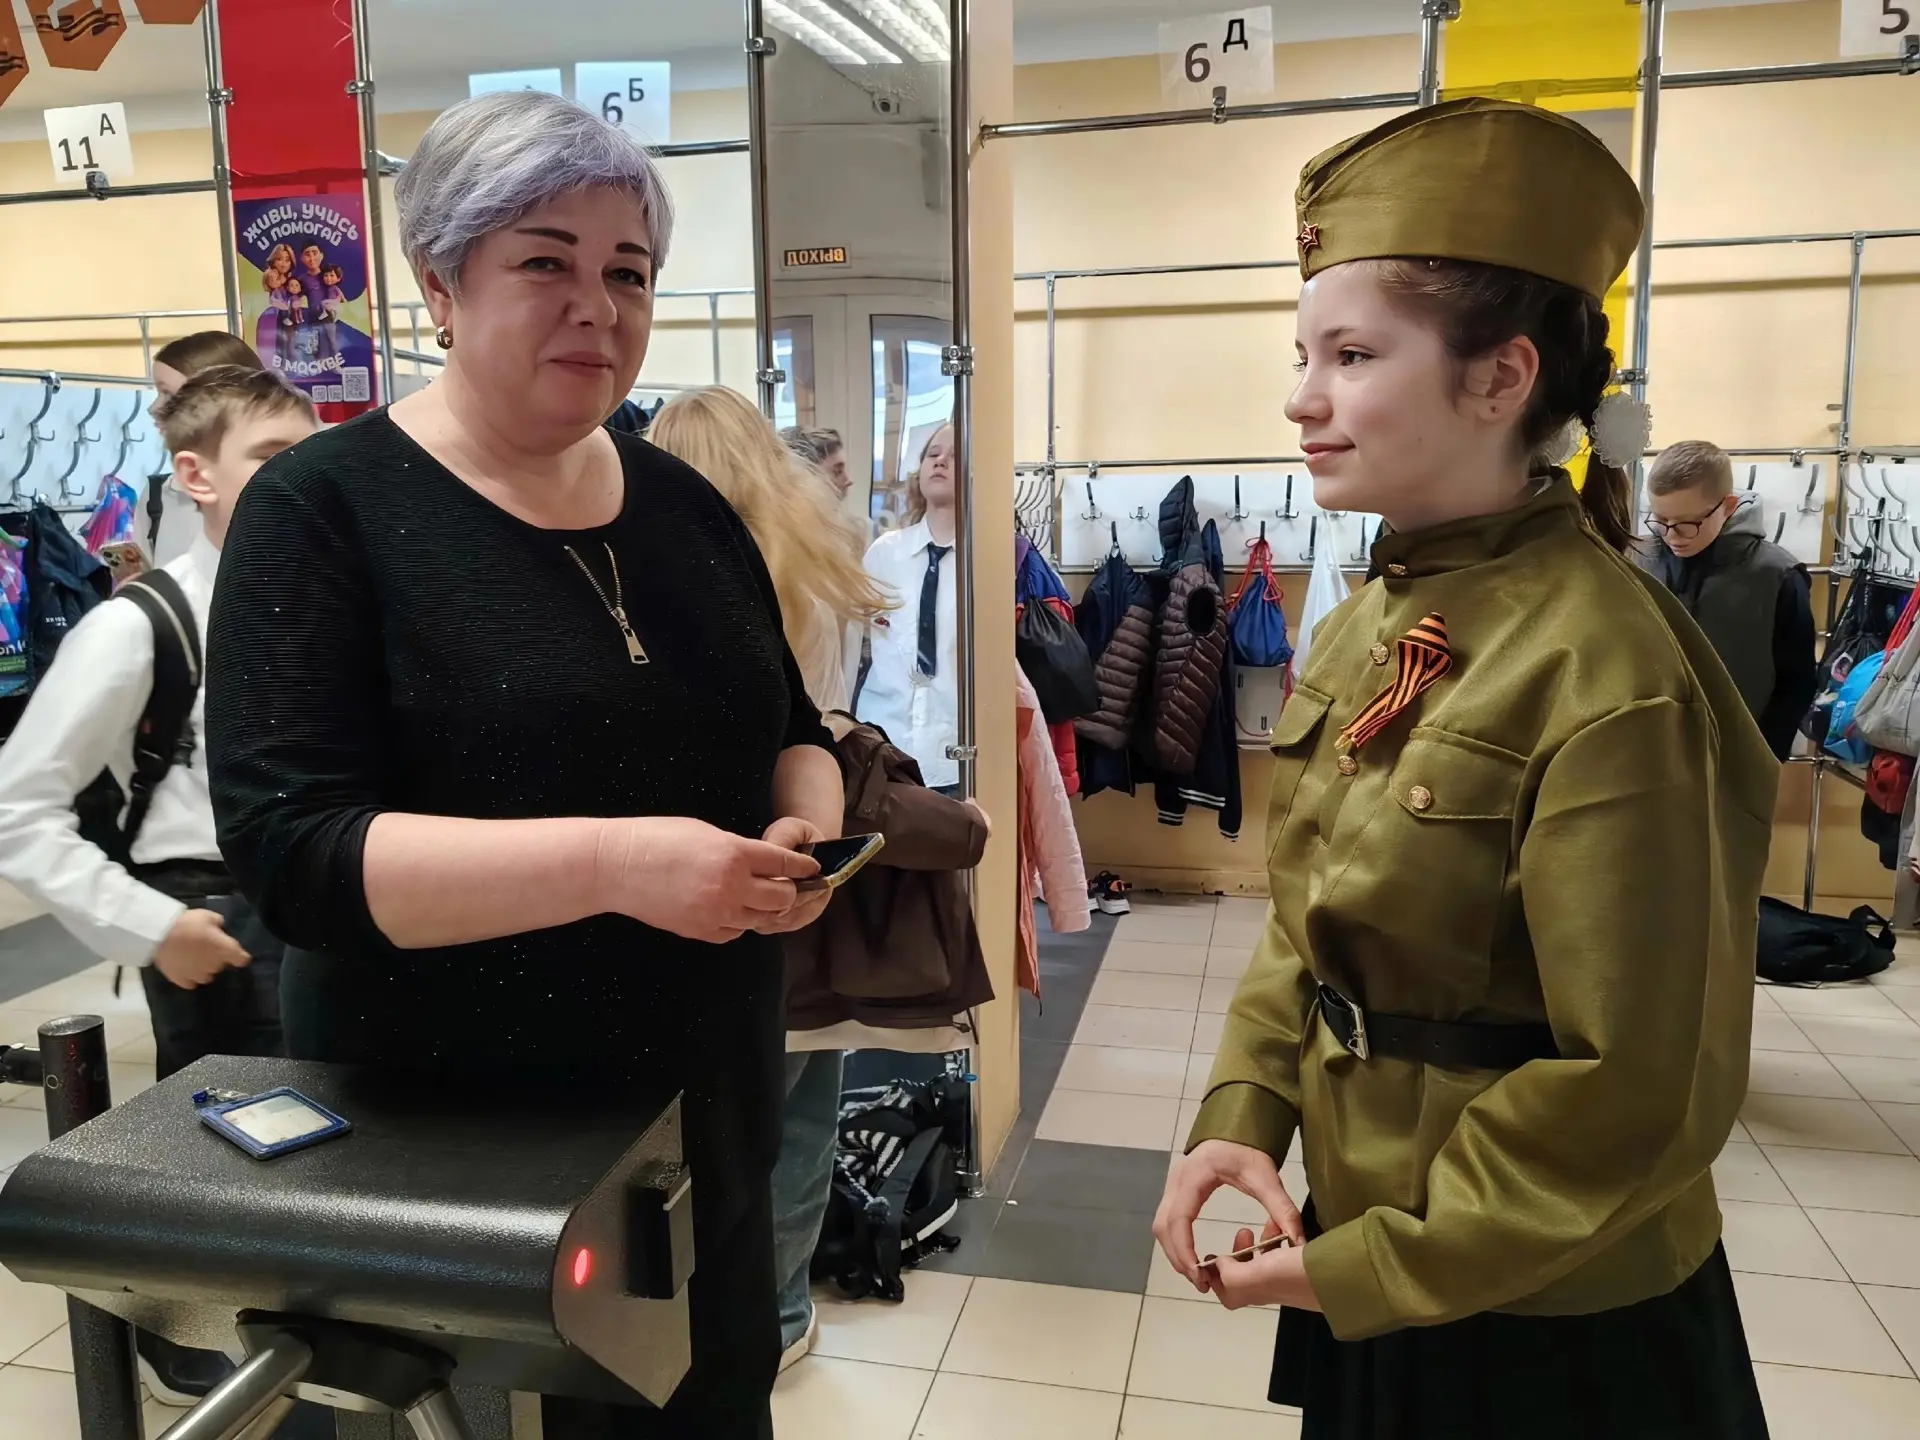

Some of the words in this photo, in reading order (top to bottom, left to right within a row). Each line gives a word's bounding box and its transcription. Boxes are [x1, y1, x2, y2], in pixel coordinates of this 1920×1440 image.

[1880, 0, 1909, 34] 5
[1184, 42, 1210, 83] 6
[1223, 18, 1248, 53] Д
[602, 92, 623, 127] 6
[628, 78, 644, 102] Б
[58, 136, 99, 171] 11
[100, 113, 116, 136] А
[243, 204, 298, 243] ЖИВИ,
[302, 203, 359, 240] УЧИСЬ
[257, 236, 270, 250] И
[270, 221, 342, 246] ПОМОГАЙ
[272, 355, 282, 368] В
[284, 352, 345, 376] МОСКВЕ
